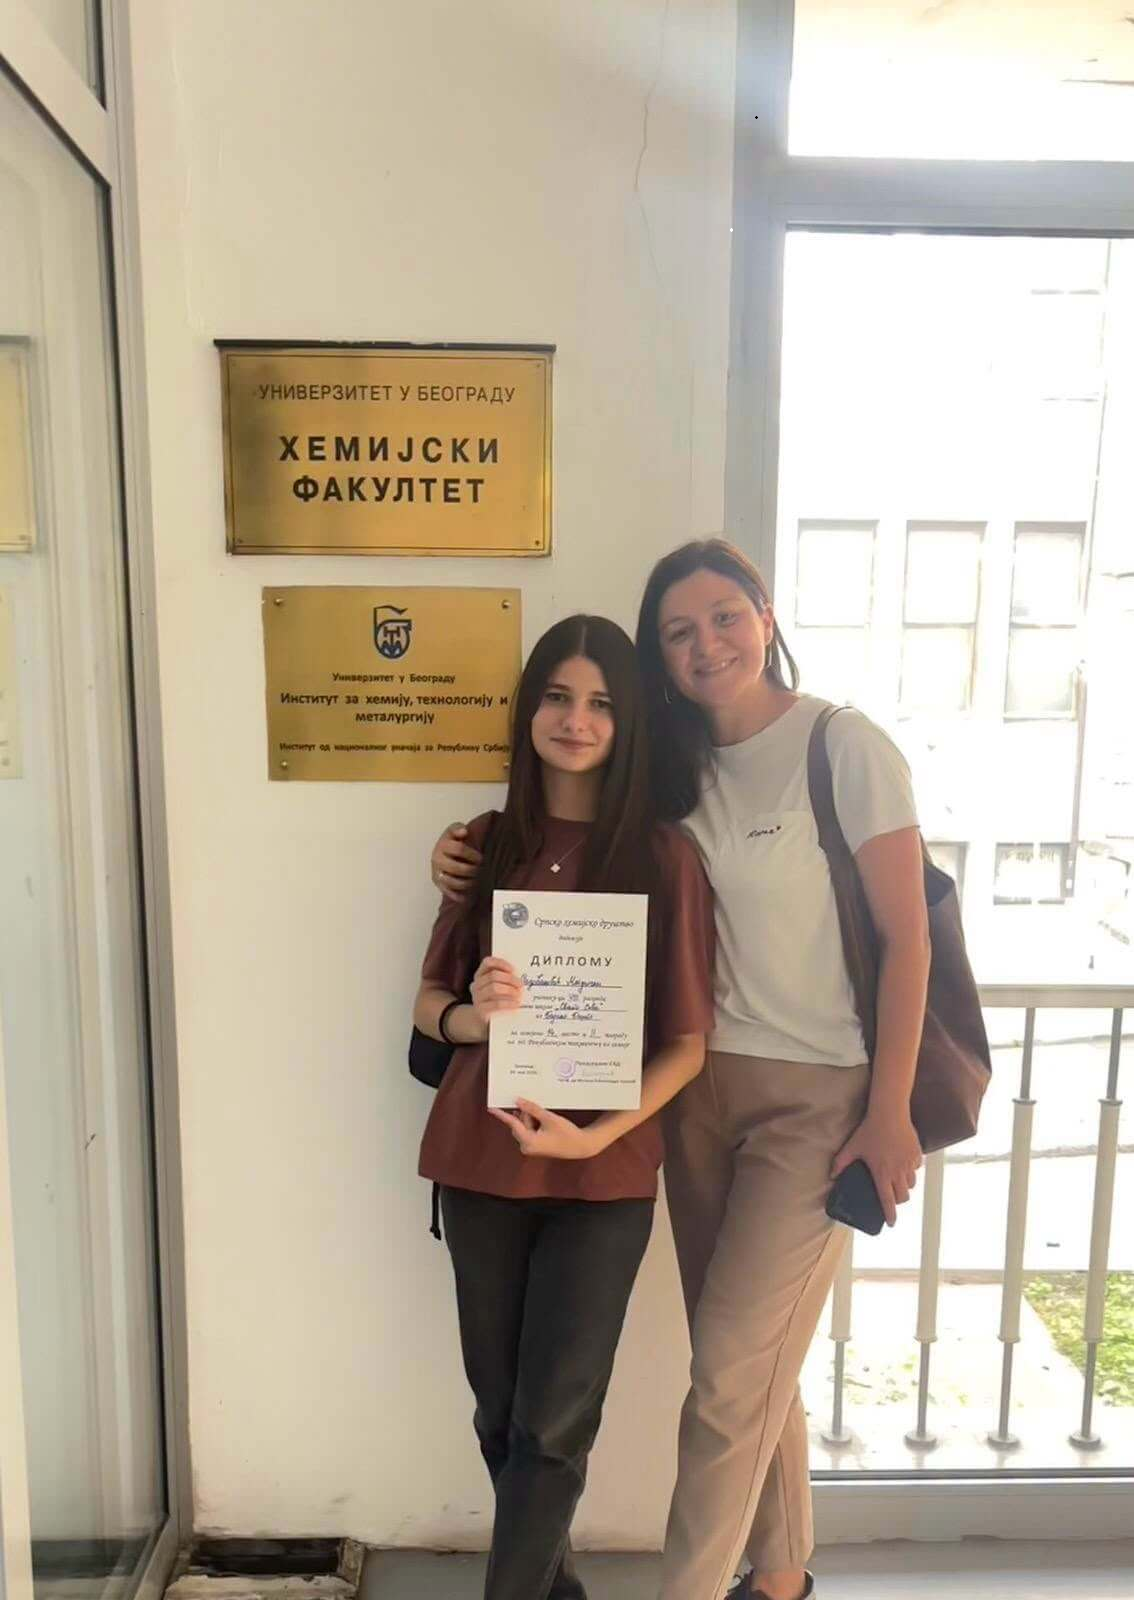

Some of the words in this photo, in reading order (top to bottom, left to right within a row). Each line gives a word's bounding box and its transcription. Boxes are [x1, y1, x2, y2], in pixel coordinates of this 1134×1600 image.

[258, 384, 393, 402] УНИВЕРЗИТЕТ
[400, 385, 411, 402] У
[417, 385, 516, 405] БЕОГРАДУ
[278, 435, 499, 464] ХЕМИЈСКИ
[292, 474, 485, 503] ФАКУЛТЕТ
[332, 672, 395, 683] Универзитет
[399, 675, 405, 684] у
[409, 673, 456, 684] Београду
[280, 692, 339, 706] Институт
[345, 695, 359, 705] за
[366, 693, 413, 707] хемију,
[416, 693, 493, 708] технологију
[500, 696, 508, 705] и
[355, 711, 435, 724] металургију
[280, 742, 316, 752] Институт
[319, 744, 331, 752] од
[437, 743, 481, 753] Републику
[530, 955, 613, 967] ДИПЛОМУ
